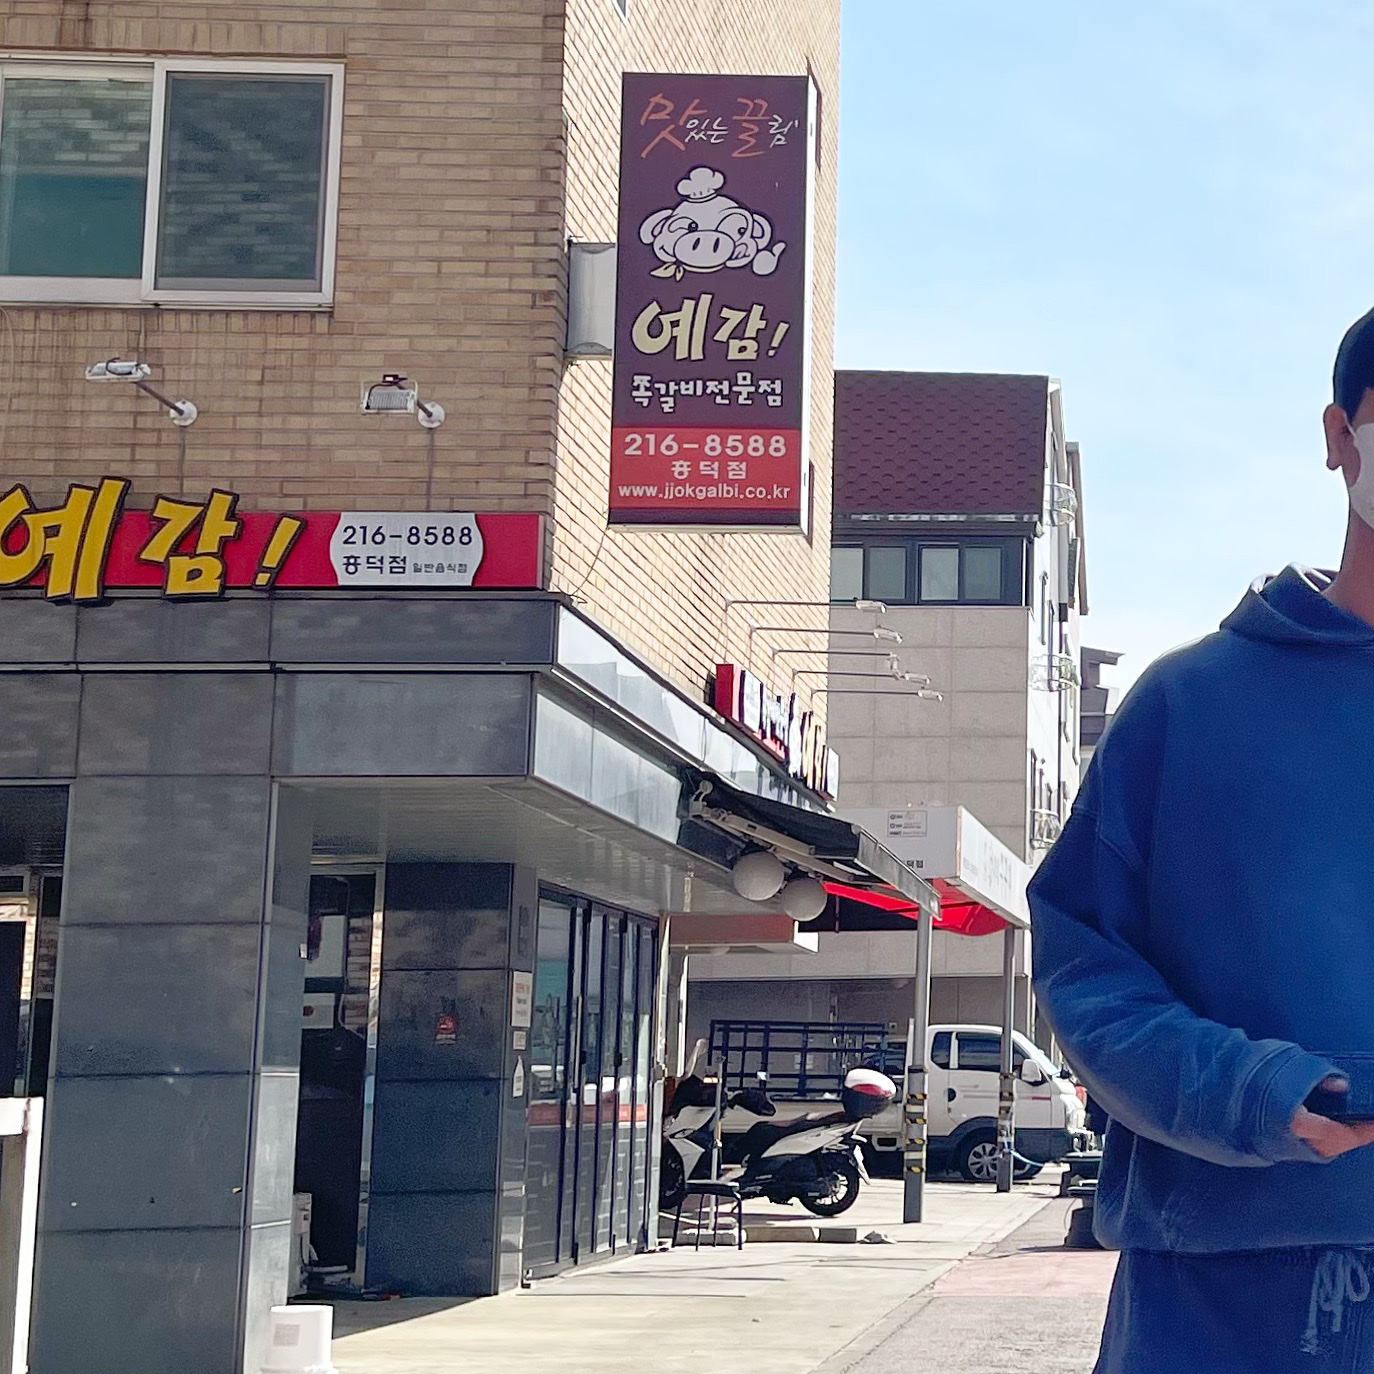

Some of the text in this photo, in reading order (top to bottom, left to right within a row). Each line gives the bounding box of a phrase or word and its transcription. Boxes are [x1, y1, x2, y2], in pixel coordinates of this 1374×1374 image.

[640, 92, 729, 159] 맛있는
[631, 293, 791, 362] 예감!
[631, 371, 784, 413] 쪽갈비전문점
[624, 433, 787, 457] 216-8588
[671, 460, 747, 480] 흥덕점
[618, 482, 791, 500] www.jjokgalbi.co.kr
[342, 525, 473, 546] 216-8588
[342, 555, 468, 575] 흥덕점 일반음식점
